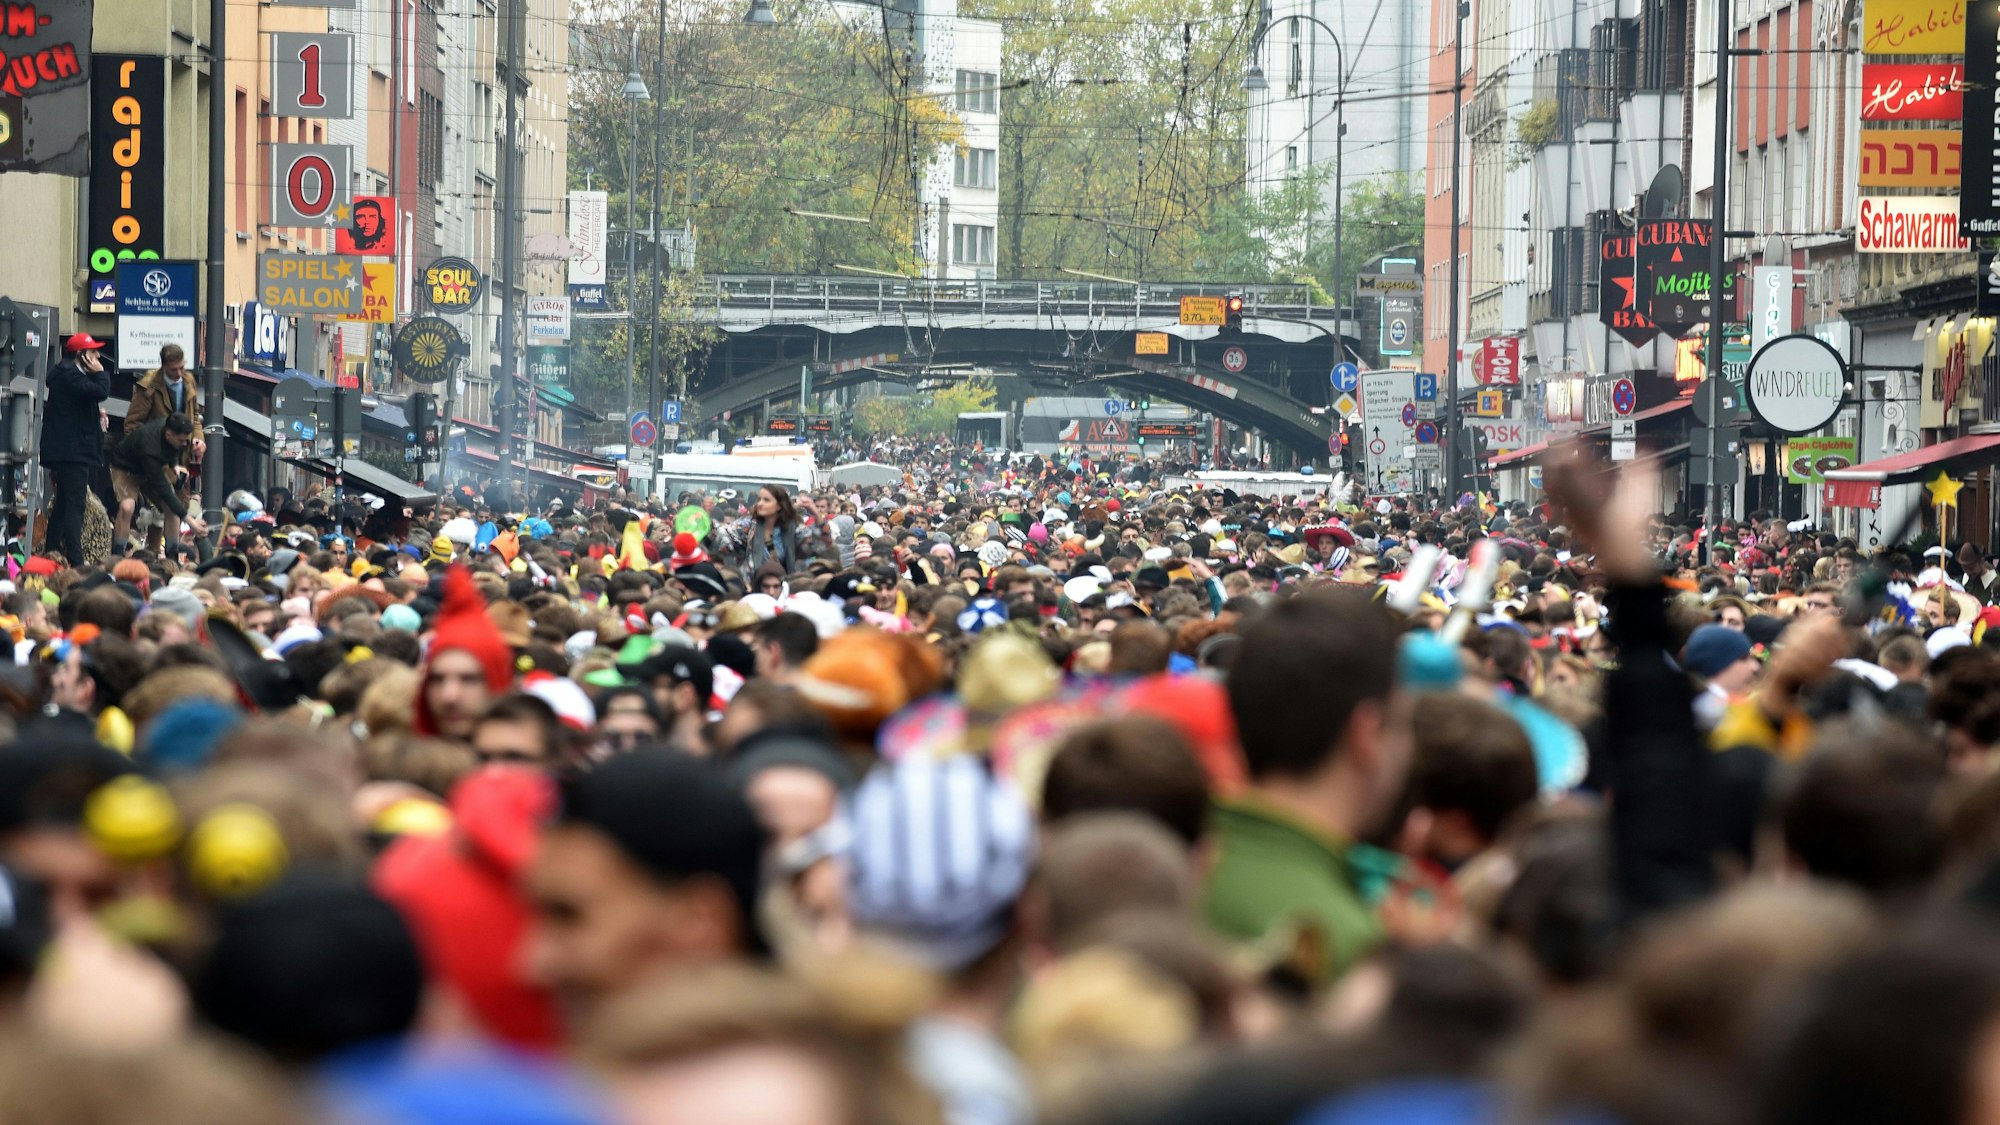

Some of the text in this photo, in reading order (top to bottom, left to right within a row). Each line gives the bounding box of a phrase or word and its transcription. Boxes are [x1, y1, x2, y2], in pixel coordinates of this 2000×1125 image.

[0, 2, 51, 37] M-
[1866, 2, 1963, 49] Habib
[297, 42, 327, 109] 1
[1863, 67, 1963, 118] Habib
[112, 60, 141, 245] radio
[266, 260, 334, 279] SPIEL
[426, 268, 478, 287] SOUL
[432, 287, 471, 304] BAR
[580, 289, 603, 299] Gaffel
[1360, 276, 1418, 295] Magnus
[1655, 272, 1734, 297] Mojits
[265, 287, 350, 308] SALON
[533, 301, 565, 311] GYROS
[1489, 339, 1513, 384] KIOSK
[1755, 369, 1839, 398] WNDRFUEL
